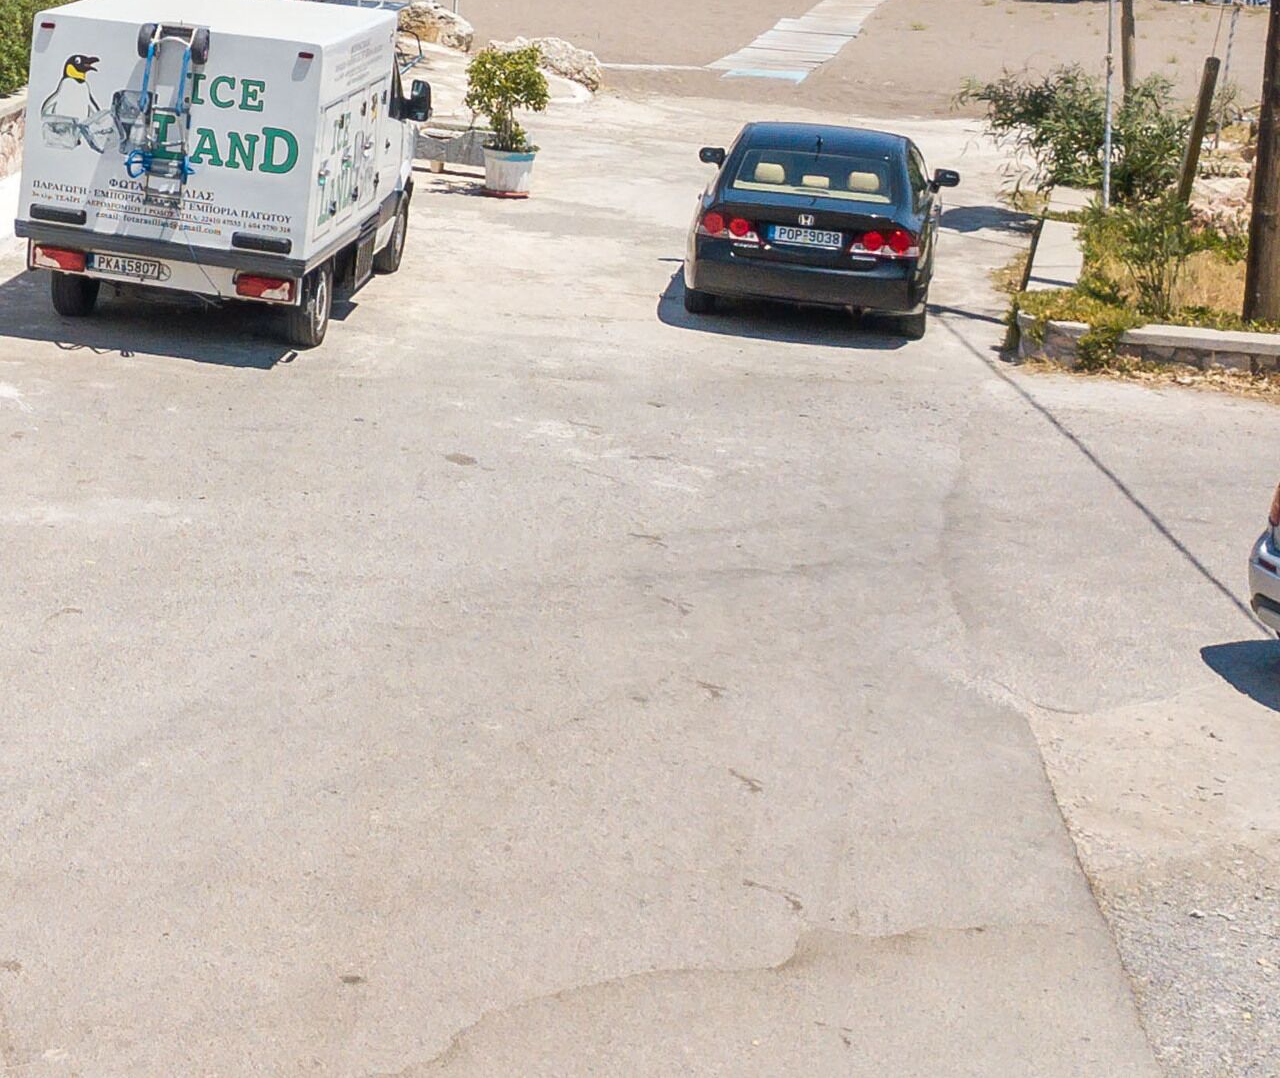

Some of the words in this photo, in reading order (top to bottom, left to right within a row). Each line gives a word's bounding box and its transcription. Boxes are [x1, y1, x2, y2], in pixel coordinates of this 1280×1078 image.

[187, 73, 266, 112] ICE
[152, 113, 299, 174] LAND
[33, 180, 87, 195] ΠΑΡΑΓΩΓΗ
[189, 203, 238, 217] ΕΜΠΟΡΙΑ
[240, 210, 292, 224] ΠΑΓΩΤΟΥ
